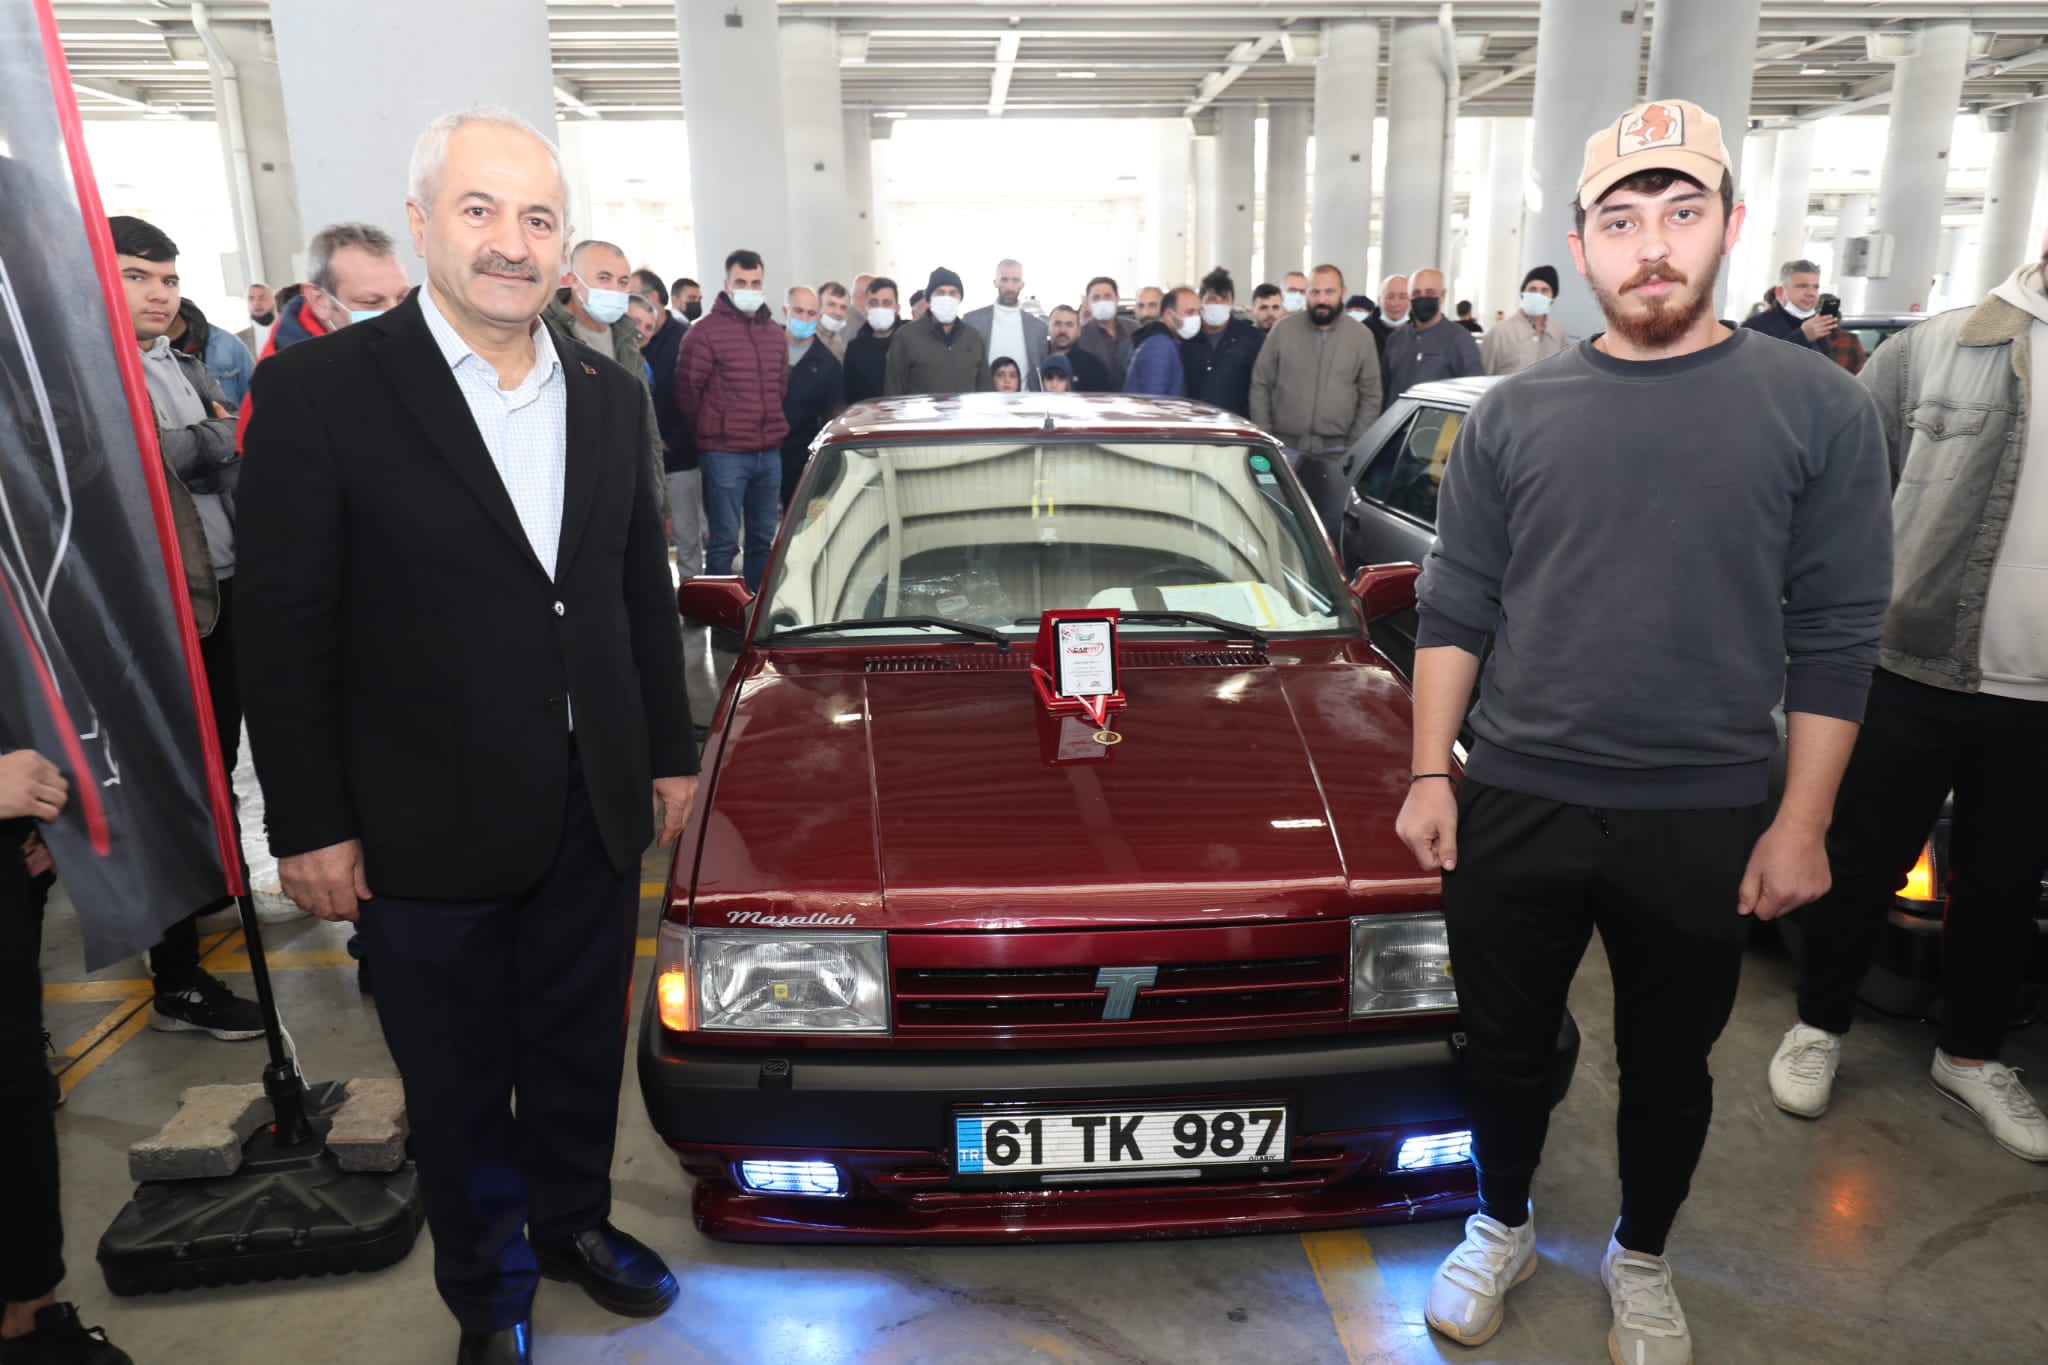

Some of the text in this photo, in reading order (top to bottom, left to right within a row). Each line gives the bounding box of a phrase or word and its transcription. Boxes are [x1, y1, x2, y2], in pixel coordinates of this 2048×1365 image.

[959, 1149, 980, 1162] TR
[985, 1111, 1284, 1167] 61 TK 987
